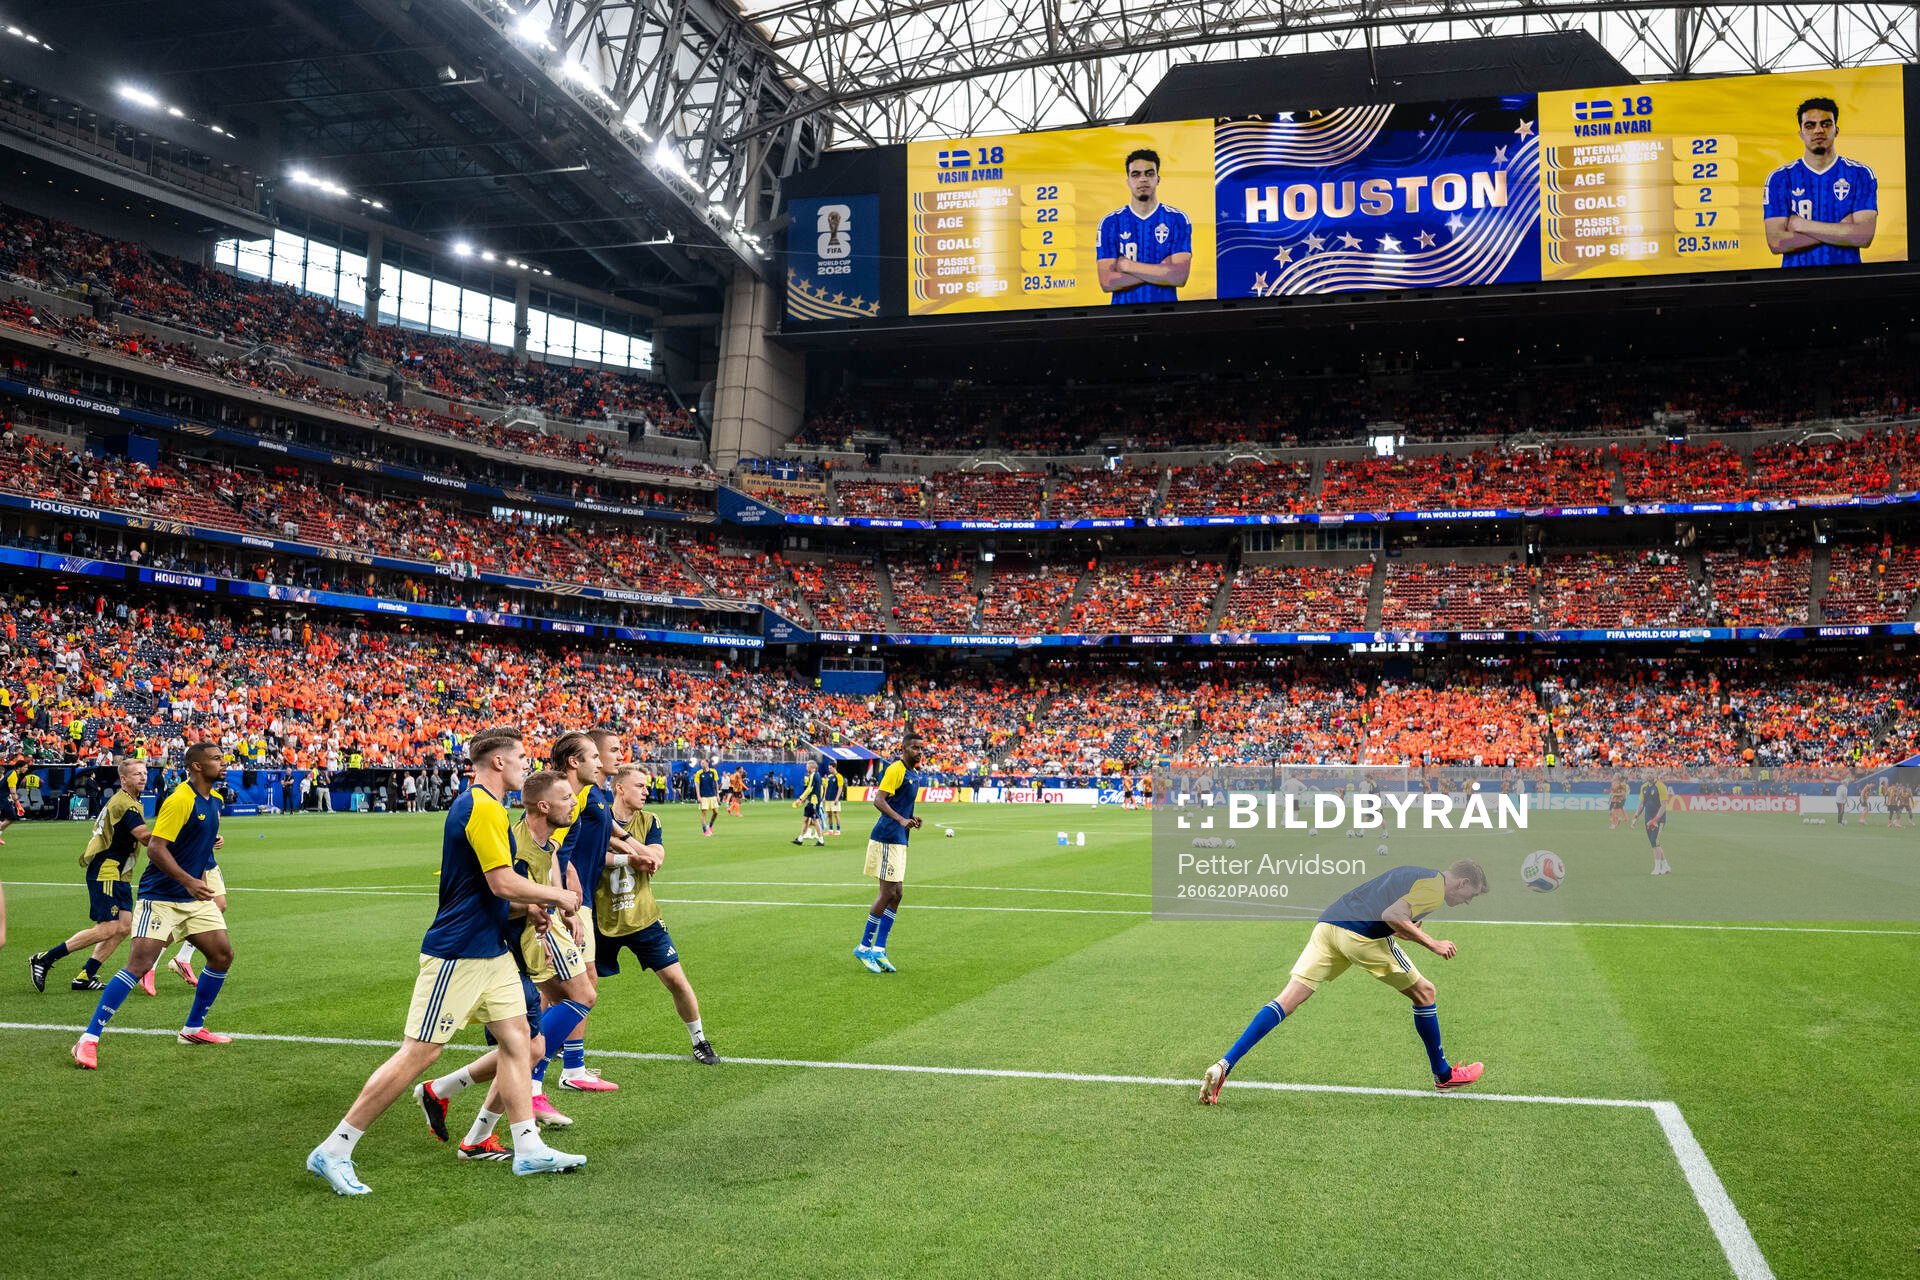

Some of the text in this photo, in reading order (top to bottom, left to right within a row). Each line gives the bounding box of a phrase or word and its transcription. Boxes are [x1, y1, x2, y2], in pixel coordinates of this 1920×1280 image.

[1622, 96, 1653, 116] 18
[1574, 120, 1651, 137] YASIN AYARI
[1692, 139, 1717, 155] 22
[978, 146, 1004, 165] 18
[937, 168, 1003, 184] YASIN AYARI
[1692, 163, 1718, 179] 22
[1574, 173, 1605, 186] AGE
[1036, 186, 1058, 200] 22
[1245, 170, 1508, 223] HOUSTON
[1700, 187, 1712, 202] 2
[937, 198, 1008, 210] APPEARAES
[1574, 195, 1627, 210] GOALS
[937, 216, 963, 229] AGE
[1036, 208, 1058, 223] 22
[1575, 216, 1620, 228] PASSES
[1695, 212, 1717, 227] 17
[937, 237, 981, 251] GOALS
[1042, 231, 1053, 244] 2
[1575, 241, 1659, 258] TOP SPEED
[937, 257, 975, 267] PASSES
[1038, 253, 1057, 267] 17
[817, 265, 851, 275] 2026
[937, 266, 996, 276] COMPLE
[937, 280, 1008, 294] TOP SPED
[28, 387, 120, 415] FIFA WORLD CUP 2026
[423, 475, 466, 488] HOUSTON
[30, 500, 100, 519] HOUSTON
[588, 503, 608, 512] WORLD
[1432, 511, 1457, 519] WORLD
[155, 572, 201, 587] HOUSTON
[618, 592, 639, 600] WORLD
[553, 623, 584, 632] HOUSTON
[1606, 630, 1711, 639] FIFA WORLD CUP 206
[1820, 627, 1869, 636] HOUSTON
[703, 636, 719, 644] FIFA
[720, 637, 746, 646] WORLD
[747, 638, 760, 646] CUP
[821, 633, 860, 641] HOUSTON
[1132, 635, 1173, 643] HOUSTON
[1460, 632, 1505, 641] HOUSTON
[925, 787, 952, 802] Lay's
[1527, 793, 1609, 810] Hisens
[1689, 796, 1797, 811] McDonald's
